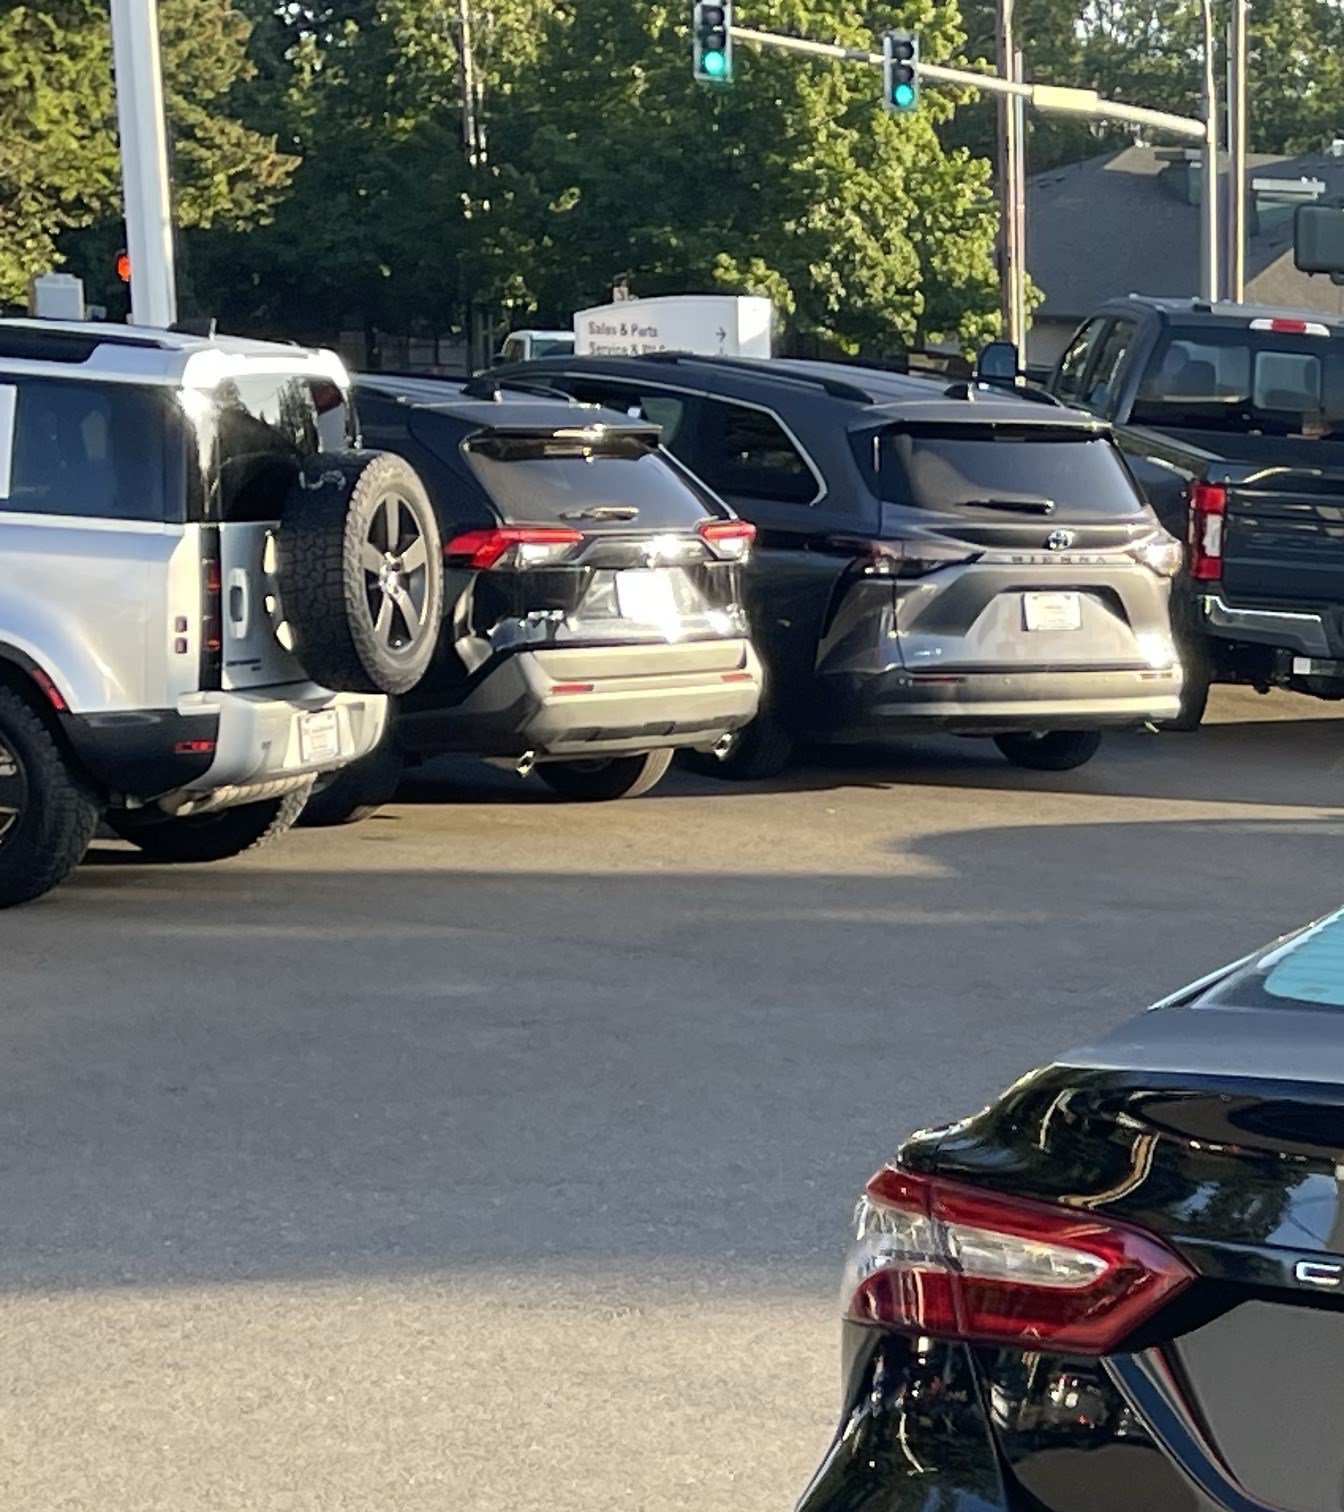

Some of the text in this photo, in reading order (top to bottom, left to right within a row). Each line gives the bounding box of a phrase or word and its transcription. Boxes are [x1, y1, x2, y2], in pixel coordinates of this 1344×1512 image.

[588, 321, 658, 338] Sales & Parts
